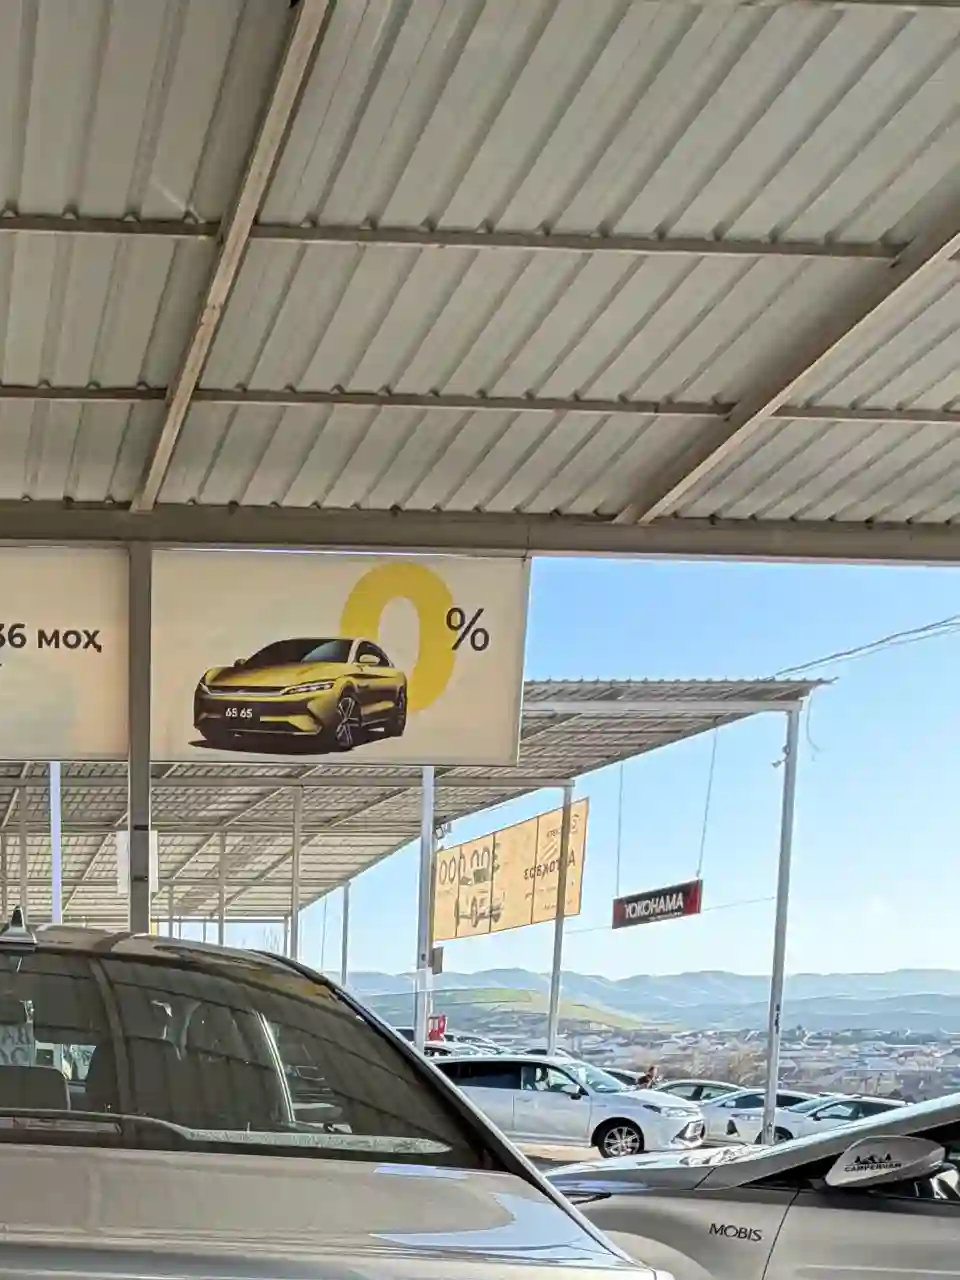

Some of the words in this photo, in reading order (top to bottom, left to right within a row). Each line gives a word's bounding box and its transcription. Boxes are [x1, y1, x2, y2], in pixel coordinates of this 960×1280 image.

[36, 628, 102, 653] моҳ
[624, 892, 684, 919] YOKOHAMA
[708, 1222, 763, 1242] MOBIS
